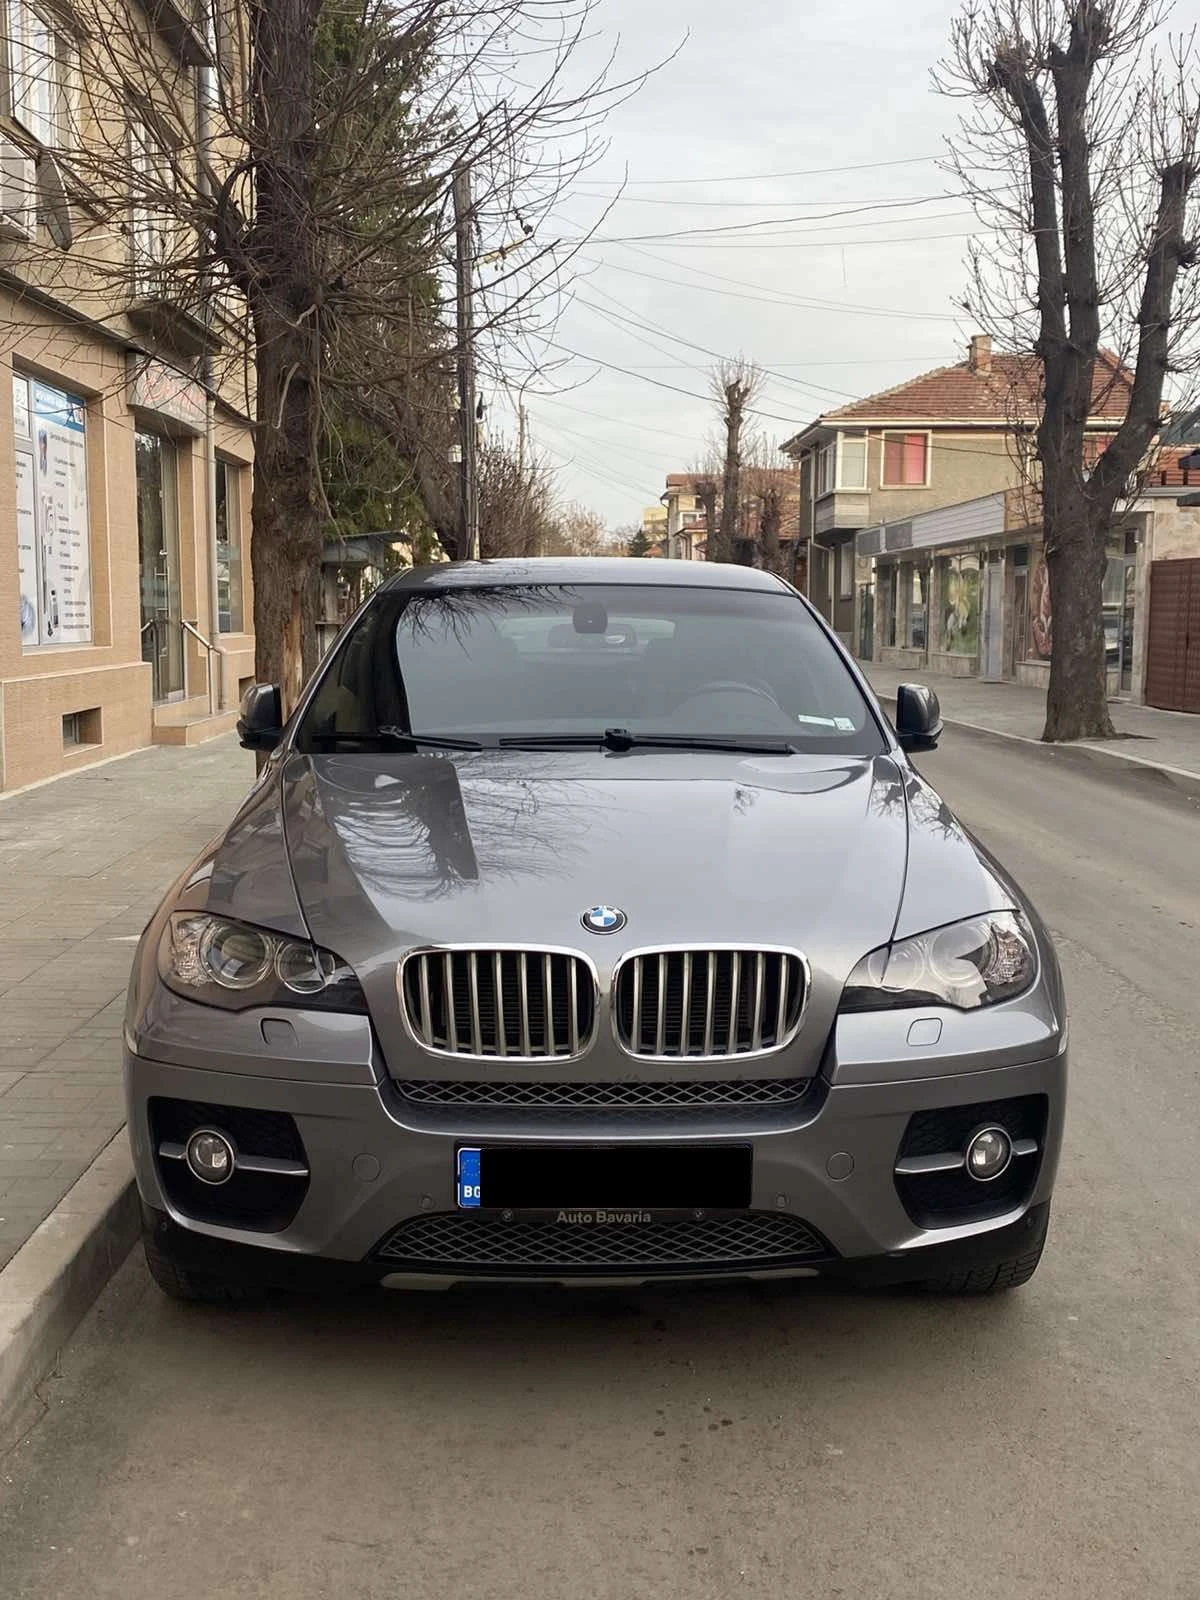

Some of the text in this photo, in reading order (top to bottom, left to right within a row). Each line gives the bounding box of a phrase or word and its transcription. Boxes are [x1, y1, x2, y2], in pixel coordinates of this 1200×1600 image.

[463, 1185, 481, 1198] BG
[556, 1210, 652, 1224] Auto Bavaria
